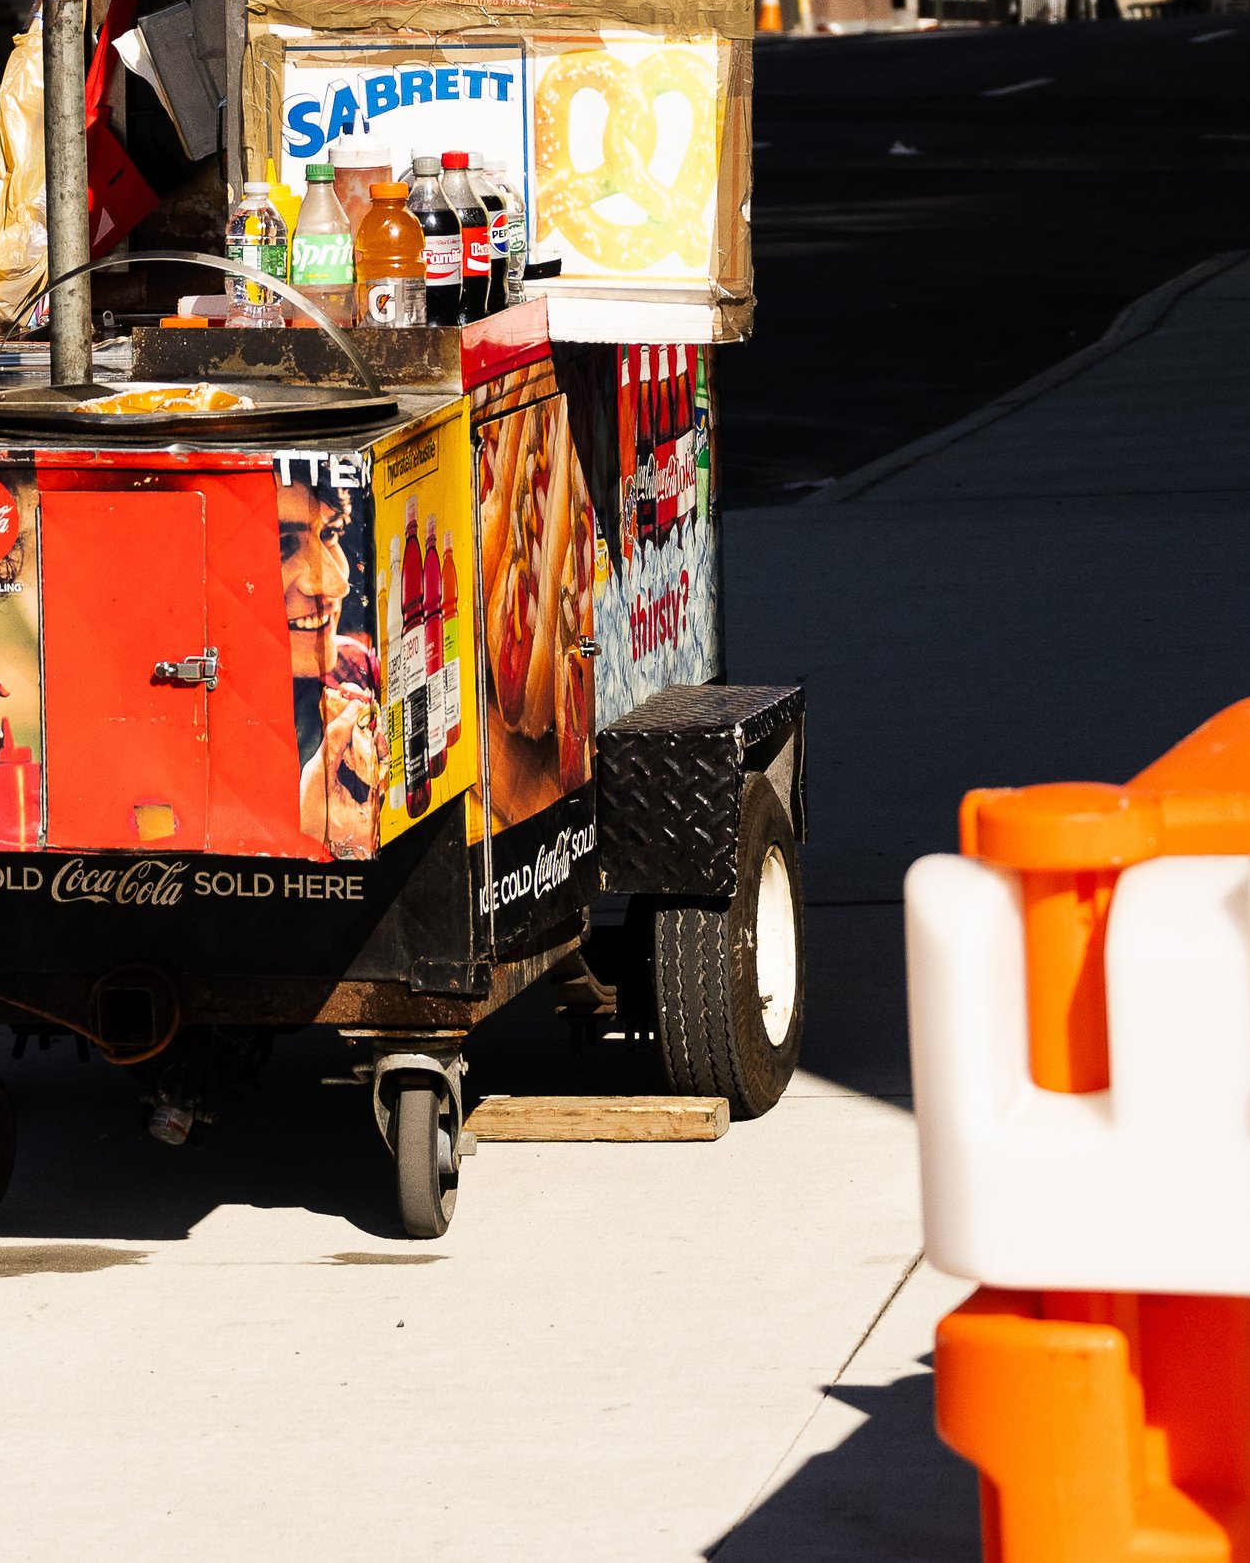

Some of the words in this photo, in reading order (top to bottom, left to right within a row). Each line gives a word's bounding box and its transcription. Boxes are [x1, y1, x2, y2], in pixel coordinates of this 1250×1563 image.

[280, 60, 514, 158] SABRETT
[630, 570, 689, 663] thirsty?
[51, 858, 191, 906] Coca-Cola
[194, 872, 275, 897] SOLD
[284, 875, 365, 900] HERE
[501, 864, 532, 905] COLD
[534, 826, 573, 900] Coca-Cola
[572, 823, 596, 861] SOLD
